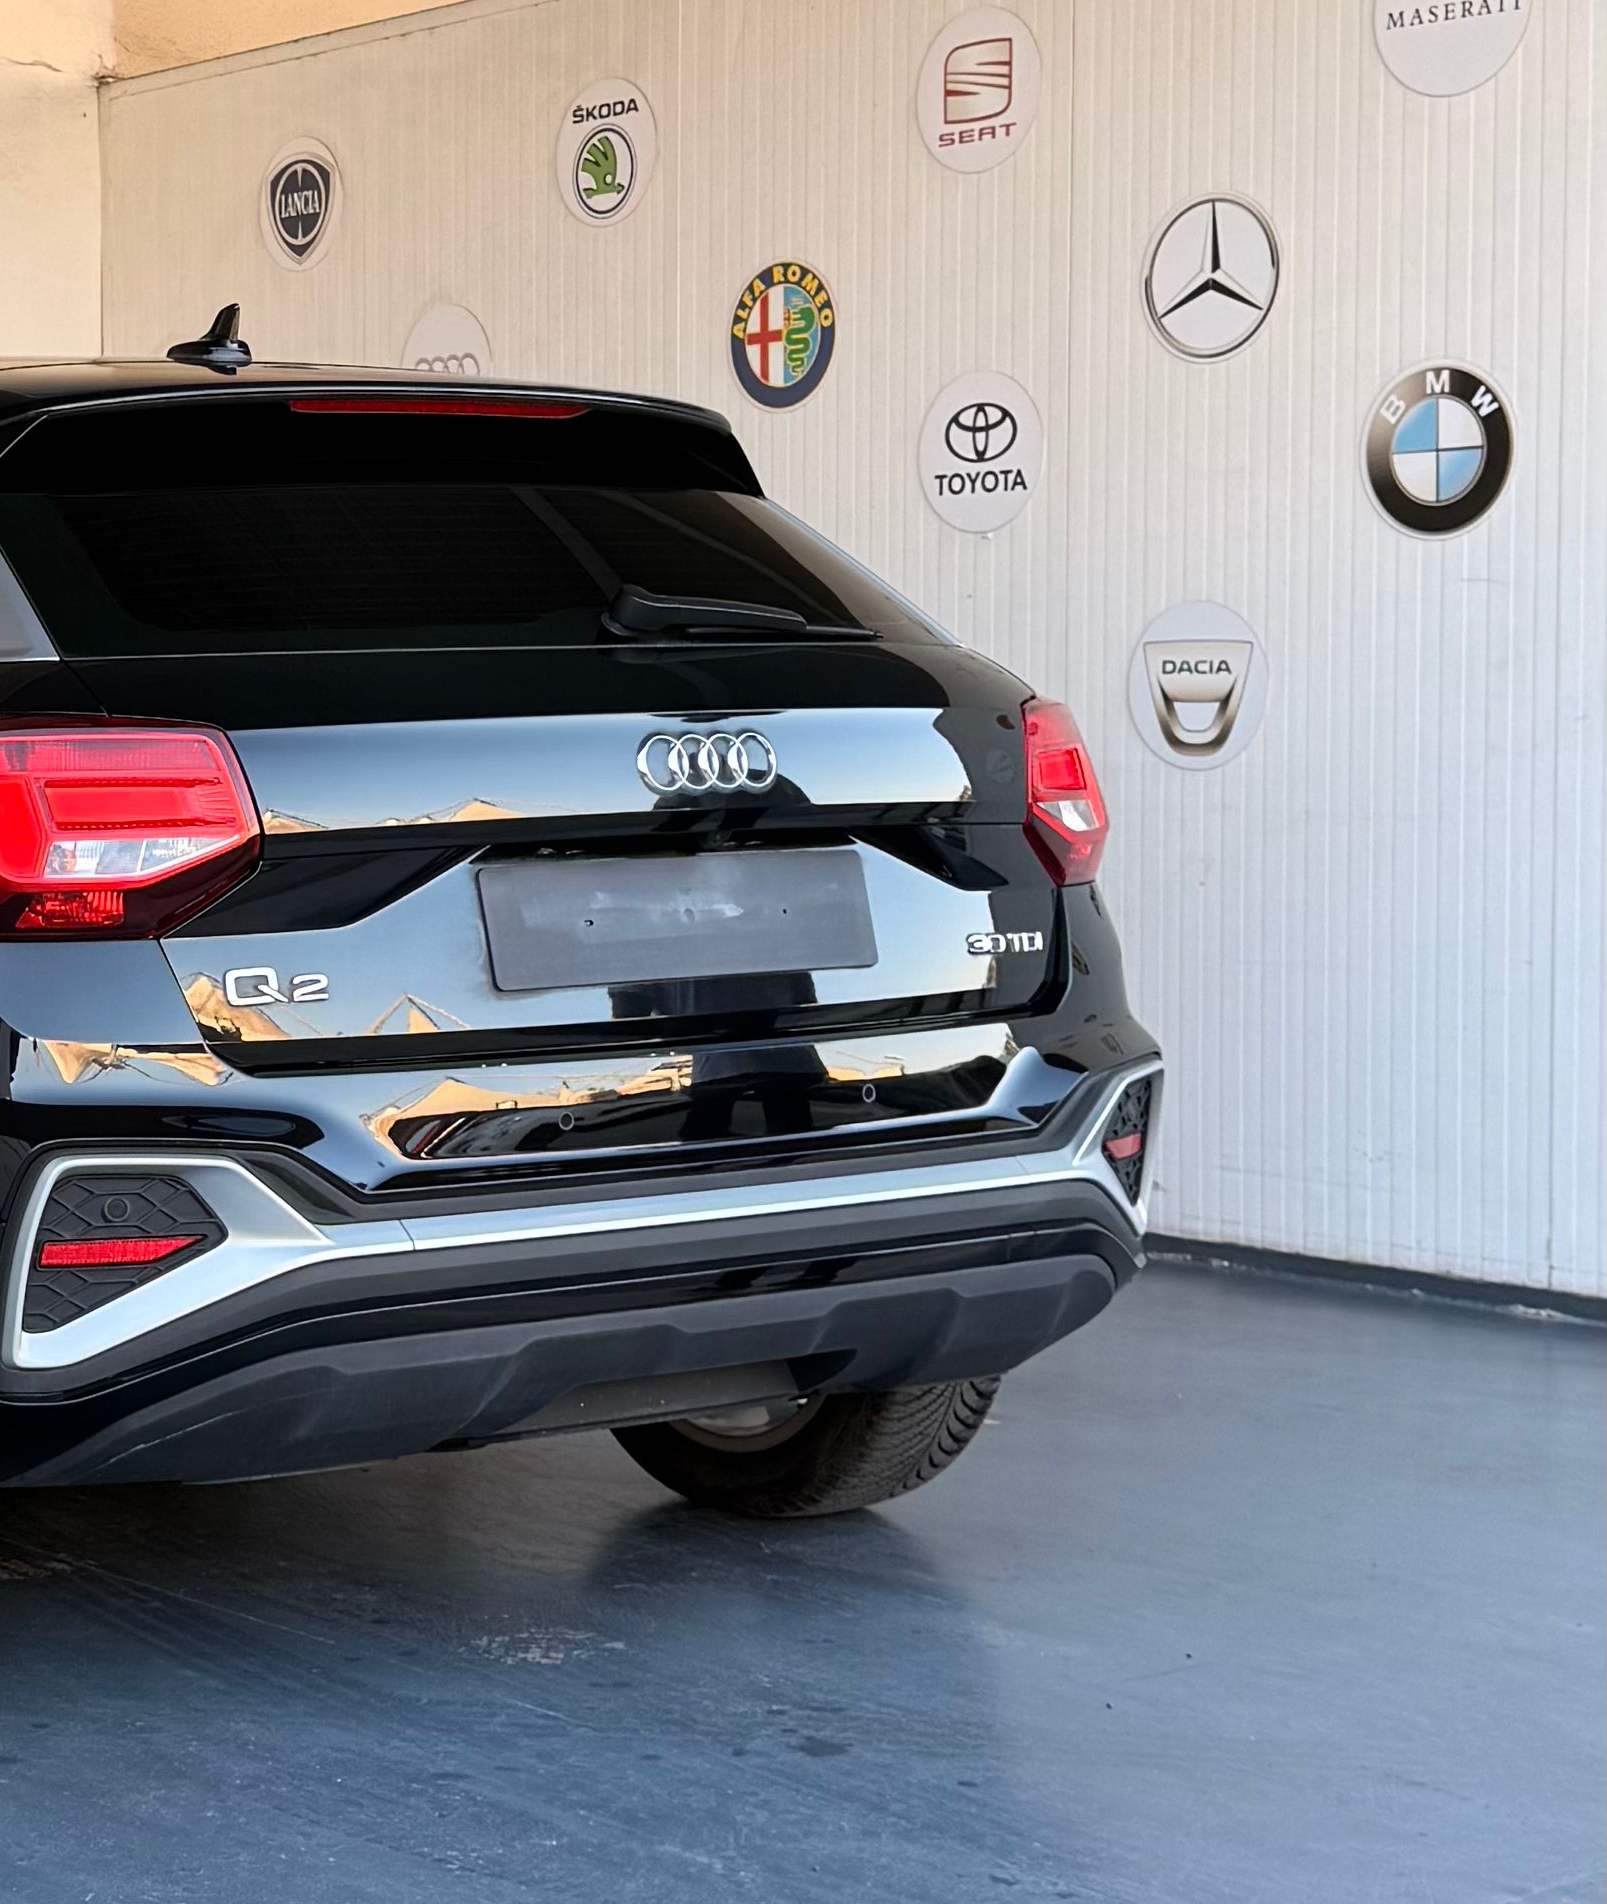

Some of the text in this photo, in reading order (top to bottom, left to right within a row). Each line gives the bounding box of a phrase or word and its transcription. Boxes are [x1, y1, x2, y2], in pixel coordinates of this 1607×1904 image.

[572, 98, 639, 124] ŠKODA
[938, 122, 1017, 148] SEAT
[280, 190, 320, 218] LANCIA
[732, 265, 833, 339] ALFA ROMEO
[1380, 369, 1499, 424] BMW
[934, 468, 1028, 496] TOYOTA
[1162, 660, 1232, 675] DACIA
[225, 966, 330, 1006] Q2
